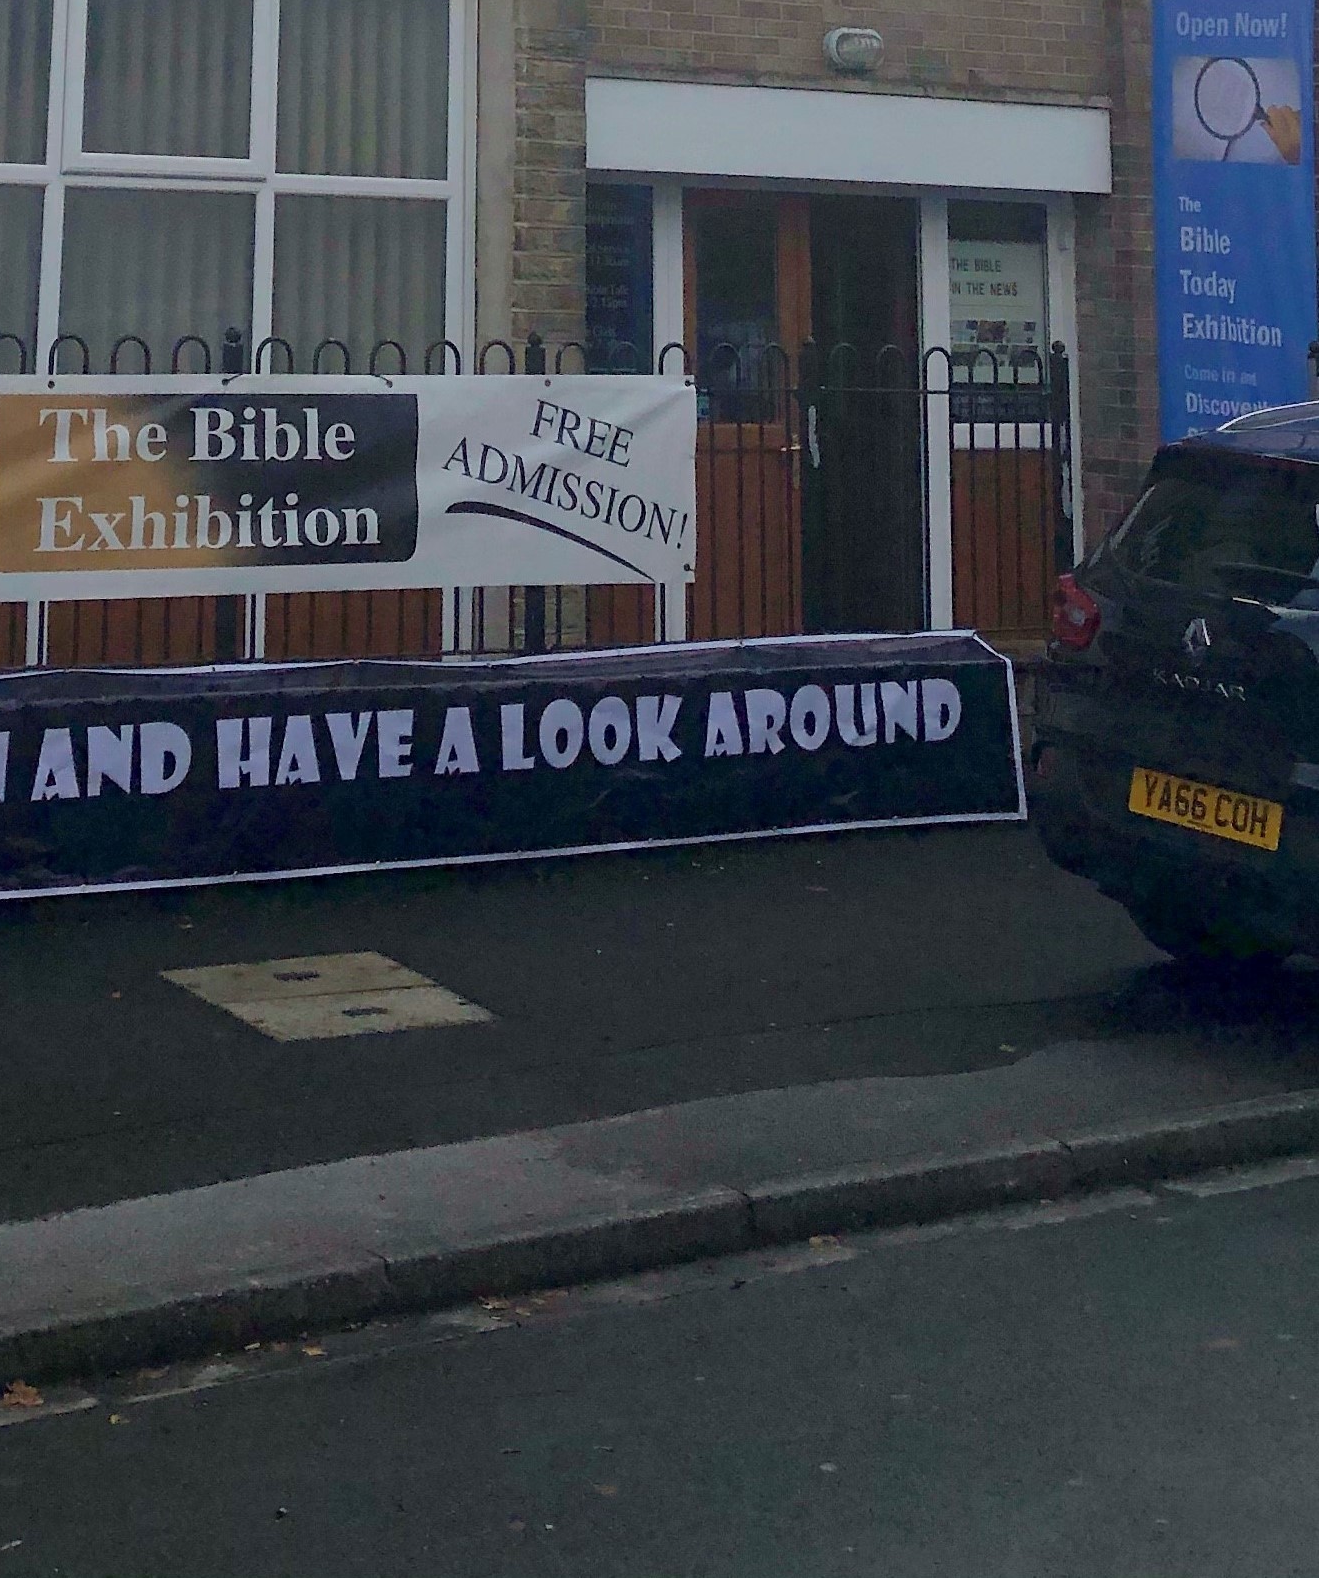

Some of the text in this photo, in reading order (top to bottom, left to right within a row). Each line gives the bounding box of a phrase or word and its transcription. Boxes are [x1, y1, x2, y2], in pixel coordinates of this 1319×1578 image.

[1176, 11, 1288, 41] Open Now!
[1178, 196, 1202, 213] The
[1180, 226, 1231, 255] Bible
[950, 258, 1002, 273] THE BIBLE
[967, 282, 985, 296] THE
[990, 281, 1018, 297] NEWS
[1179, 269, 1237, 304] Today
[1182, 312, 1283, 348] Exhibition
[38, 406, 357, 464] The Bible
[528, 398, 634, 468] FREE
[440, 436, 689, 549] ADMISSION!
[33, 493, 382, 554] Exhibition
[30, 719, 193, 804] AND
[214, 708, 414, 790] HAVE
[433, 705, 478, 777] A
[497, 693, 683, 772] LOOK
[701, 677, 964, 760] AROUND
[1144, 772, 1270, 839] YA66 COH
